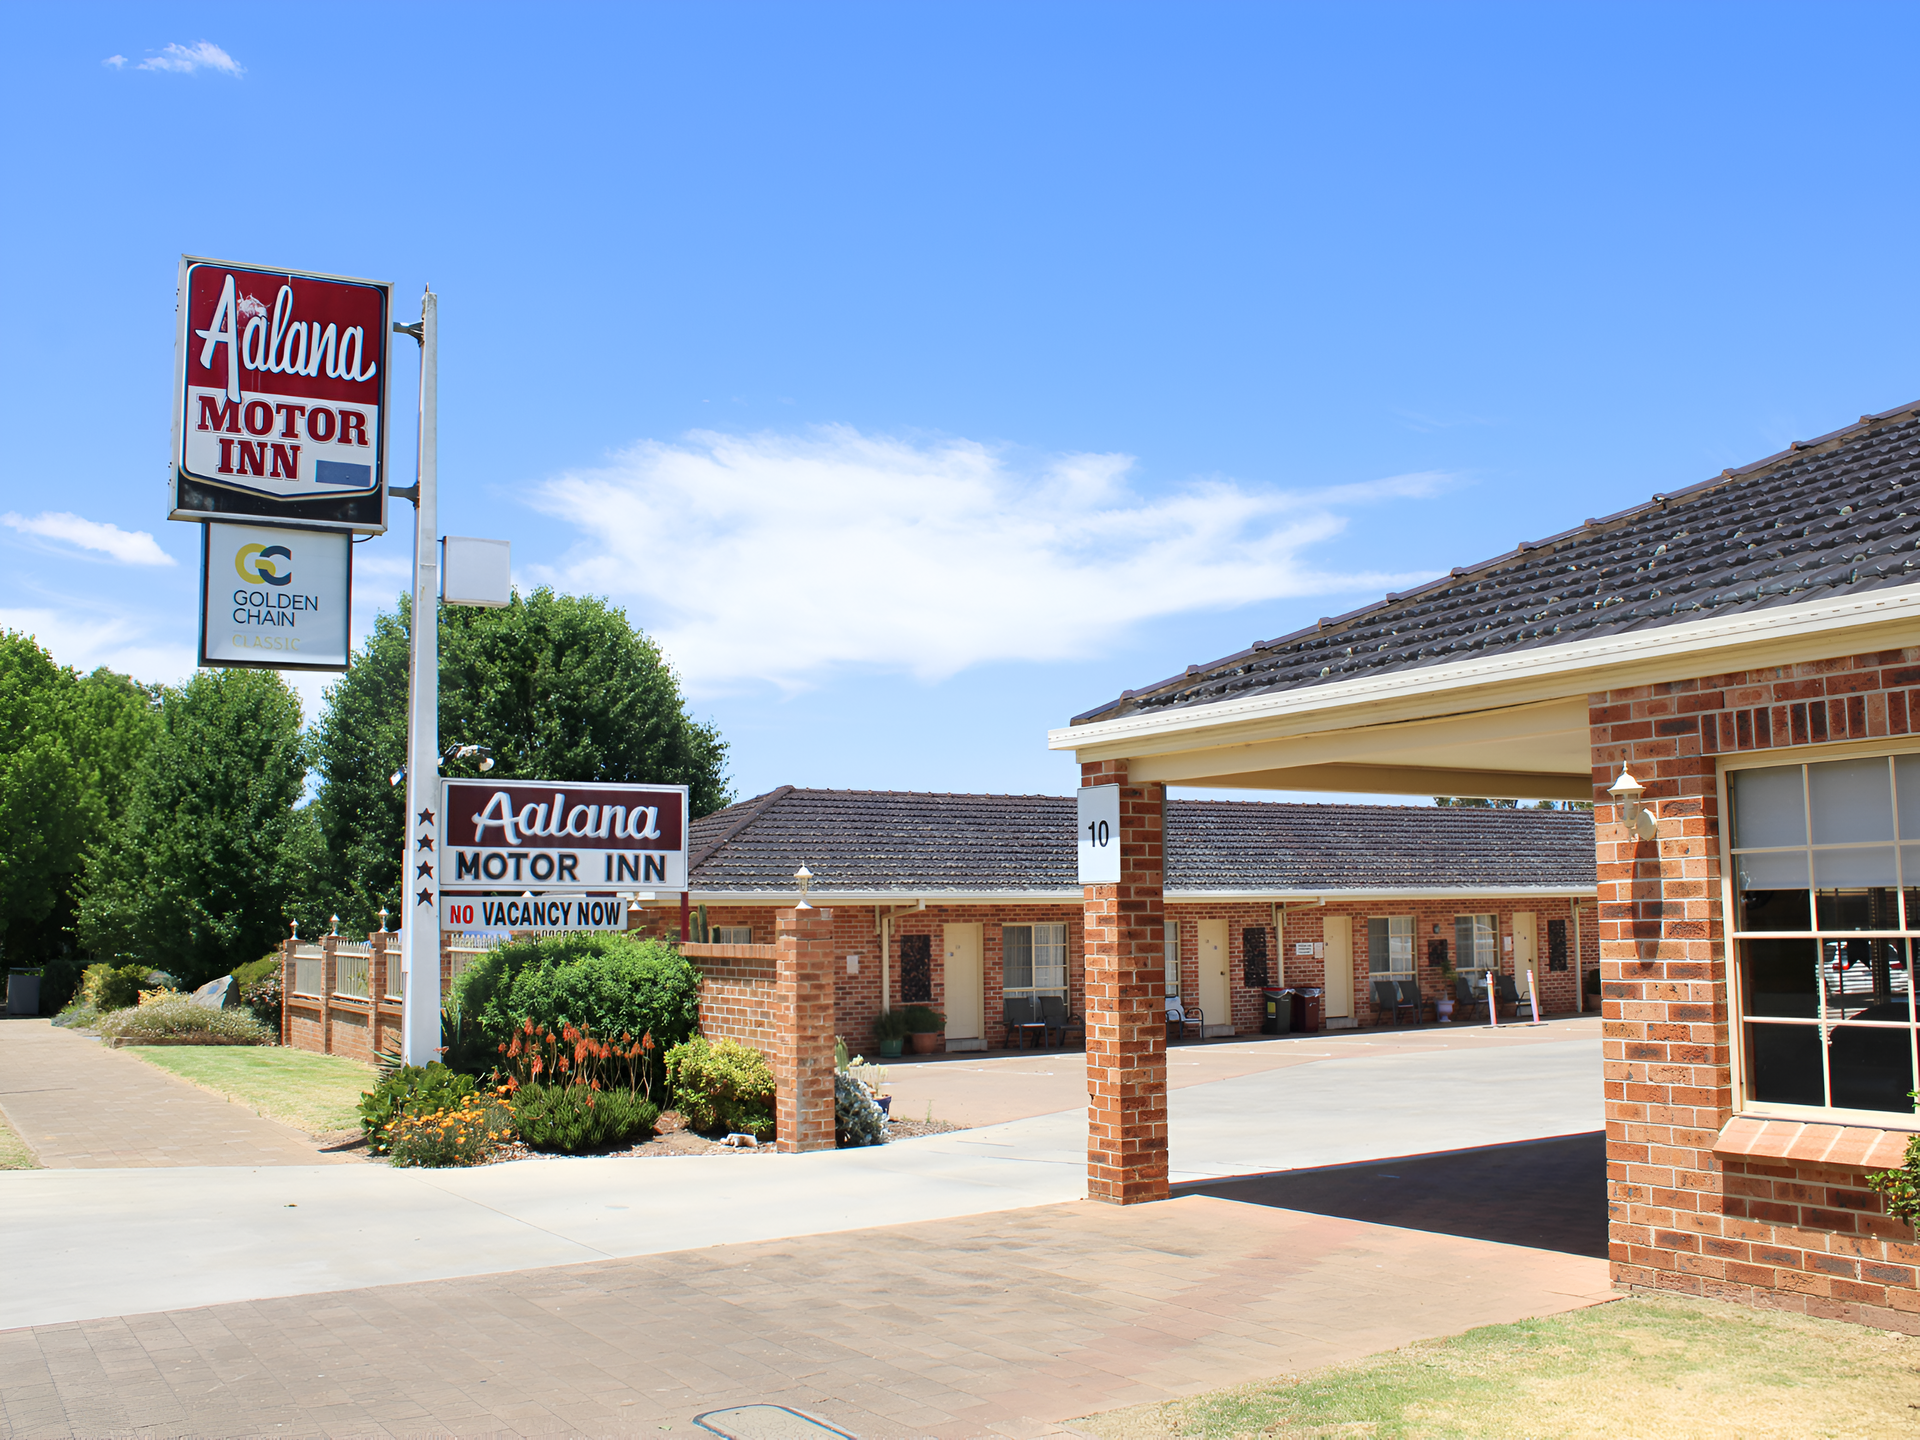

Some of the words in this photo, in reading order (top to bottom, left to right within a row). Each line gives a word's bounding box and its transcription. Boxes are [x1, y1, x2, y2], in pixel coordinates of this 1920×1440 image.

[195, 273, 377, 404] Aalana
[197, 395, 370, 447] MOTOR
[217, 437, 301, 480] INN
[233, 589, 319, 611] GOLDEN
[232, 607, 295, 627] CHAIN
[232, 633, 301, 651] CLASSIC
[471, 791, 661, 846] Aalana
[1087, 819, 1110, 848] 10
[455, 850, 580, 882] MOTOR
[605, 853, 667, 883] INN
[450, 904, 475, 925] NO
[482, 901, 573, 926] VACANCY
[577, 901, 622, 926] NOW
